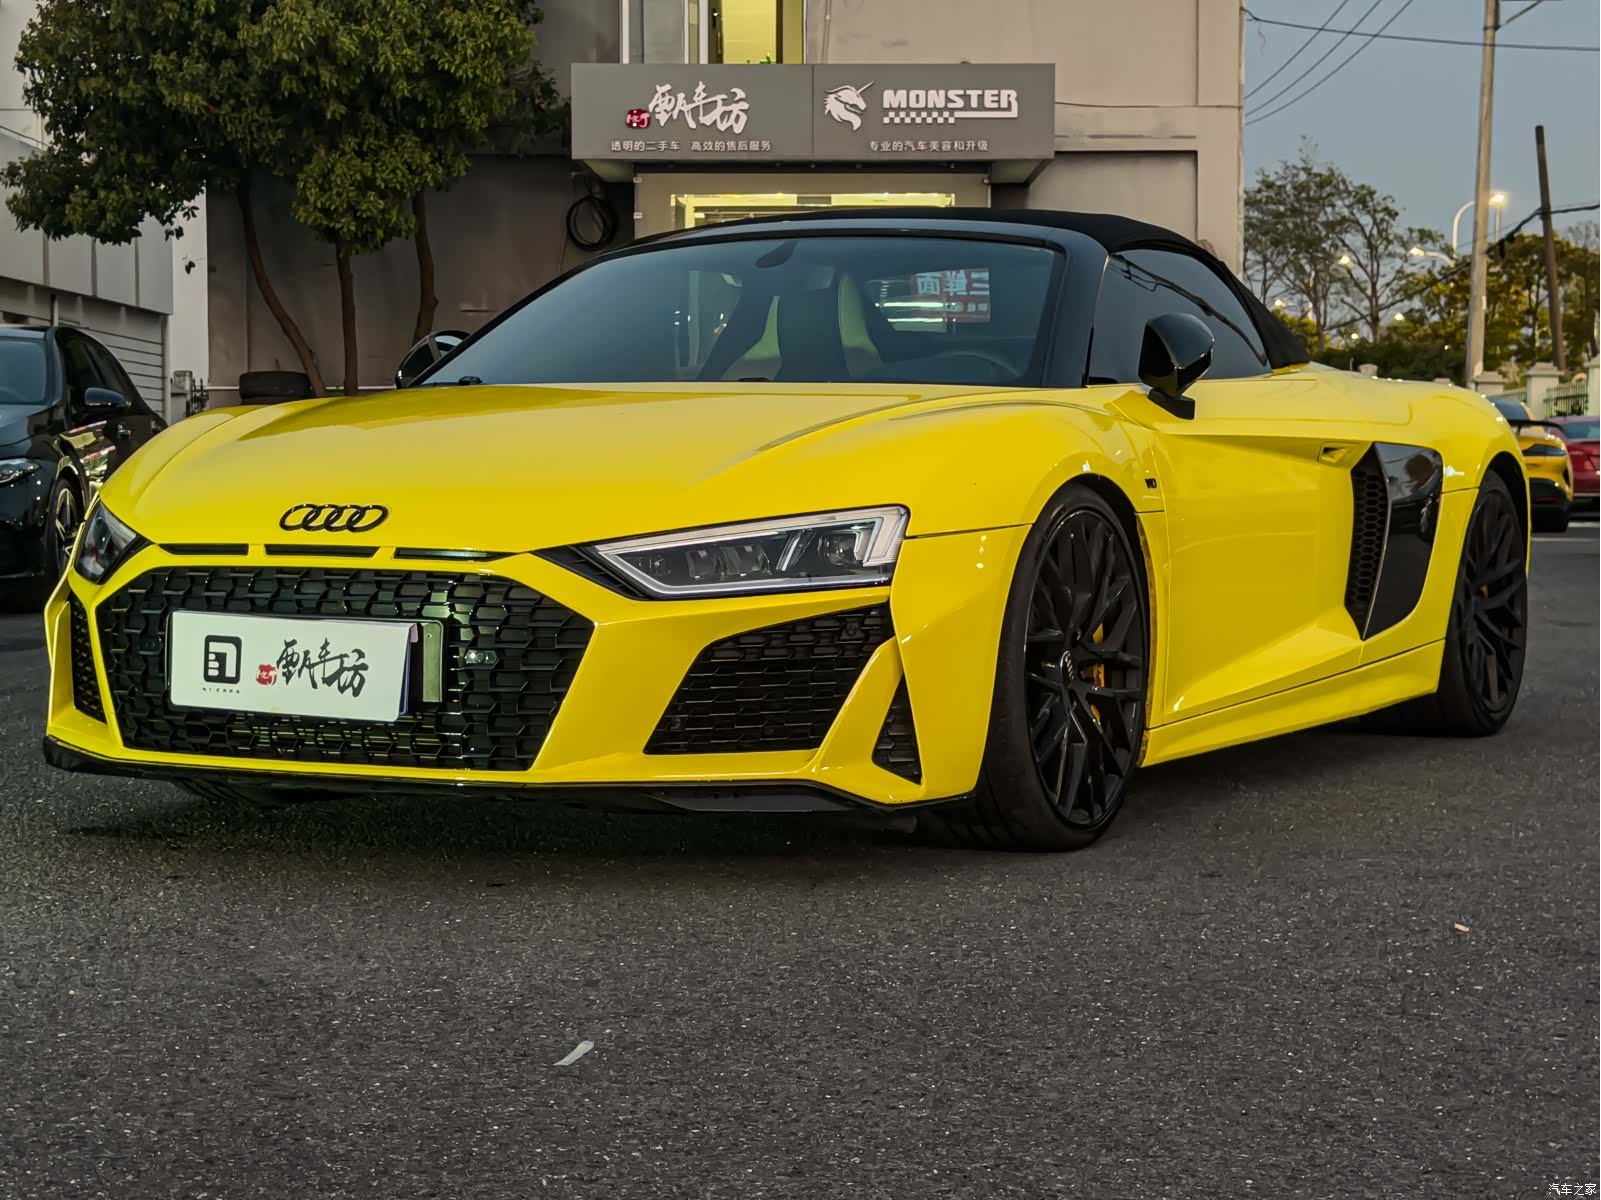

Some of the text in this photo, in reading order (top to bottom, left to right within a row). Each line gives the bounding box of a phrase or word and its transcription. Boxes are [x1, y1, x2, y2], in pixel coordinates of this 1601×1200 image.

[883, 89, 1018, 113] MONSTER
[611, 140, 771, 152] 透明的二手车 高效的售后服务
[869, 140, 989, 151] 专业的汽车美容和升级
